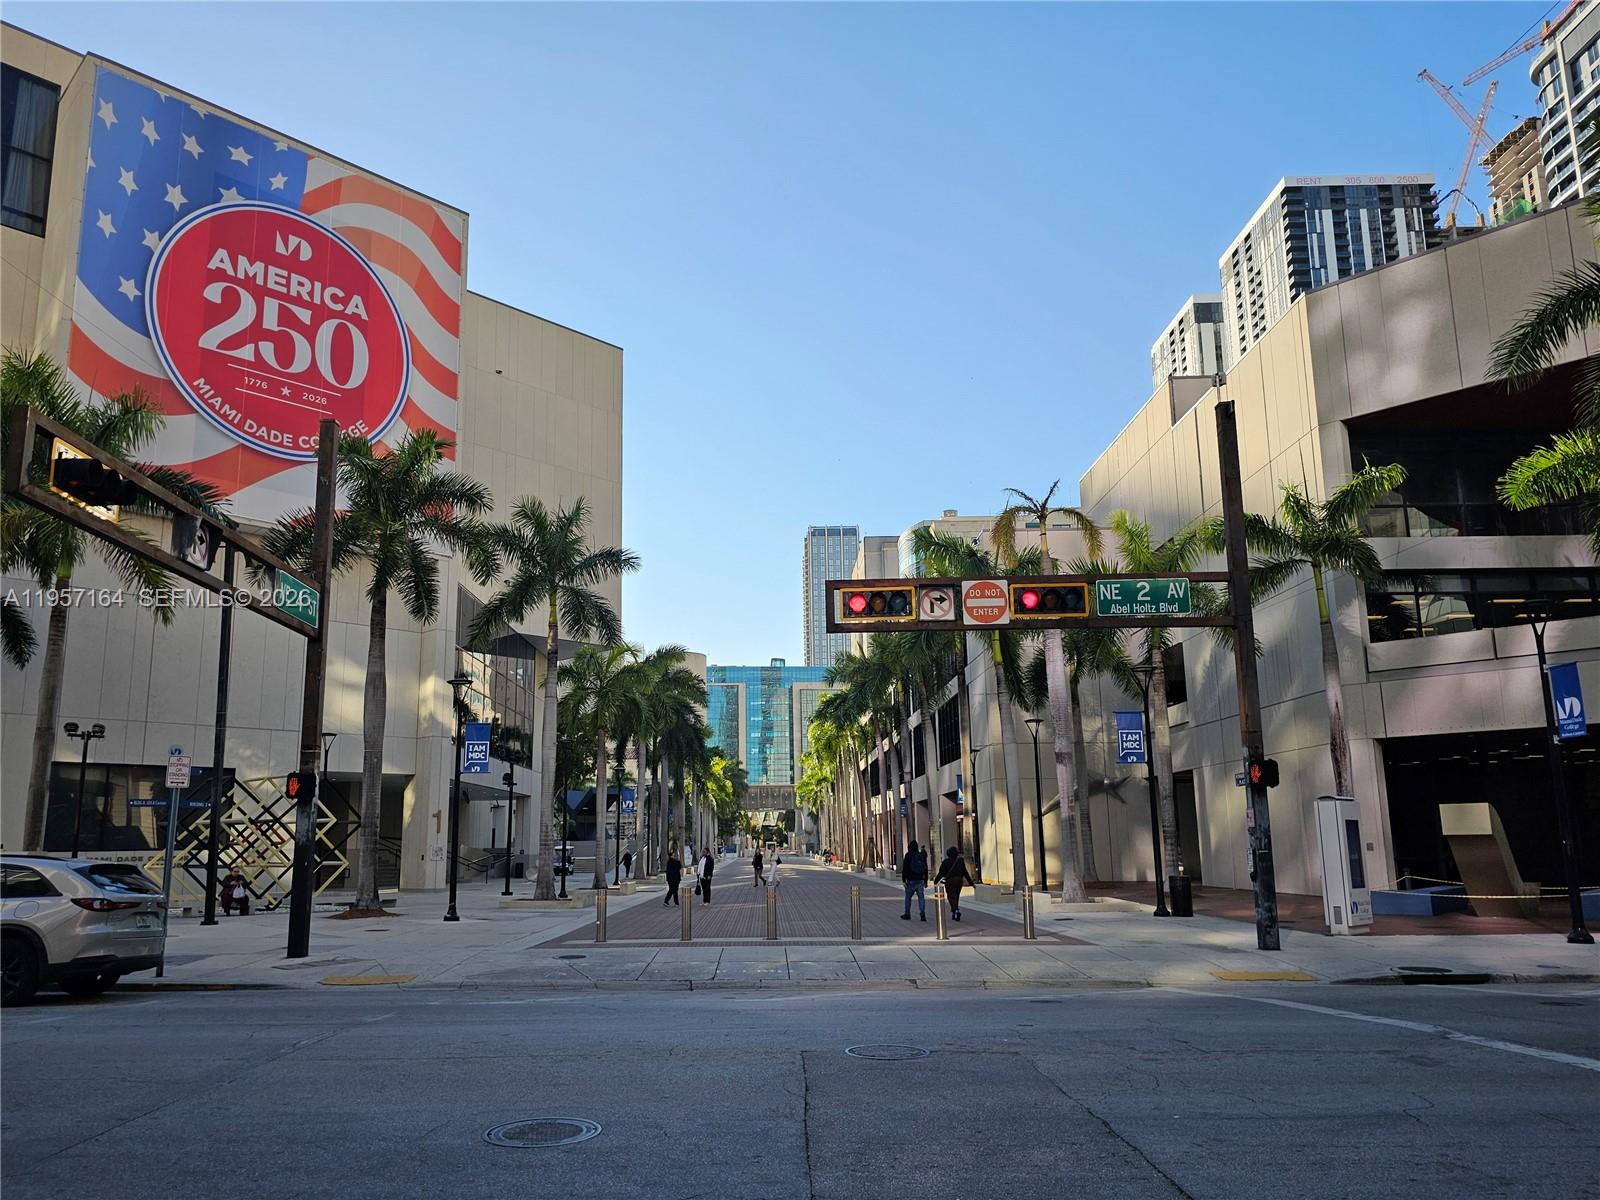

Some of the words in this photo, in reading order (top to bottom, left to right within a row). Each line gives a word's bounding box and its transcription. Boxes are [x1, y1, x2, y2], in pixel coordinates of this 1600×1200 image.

[1297, 176, 1322, 185] RENT
[1345, 176, 1362, 184] 305
[1397, 175, 1419, 183] 2500
[207, 248, 369, 321] AMERICA
[198, 281, 369, 390] 250
[244, 376, 268, 389] 1776
[302, 392, 327, 405] 2026
[192, 377, 242, 425] MIAMI
[243, 418, 293, 447] DADE
[970, 589, 981, 597] DO
[1100, 584, 1122, 600] NE
[1137, 581, 1150, 600] 2
[1167, 582, 1185, 599] AV
[973, 608, 999, 616] ENTER
[1110, 603, 1130, 614] Abel
[1133, 602, 1156, 613] Holtz
[1159, 603, 1179, 613] Blvd
[432, 809, 441, 834] 1
